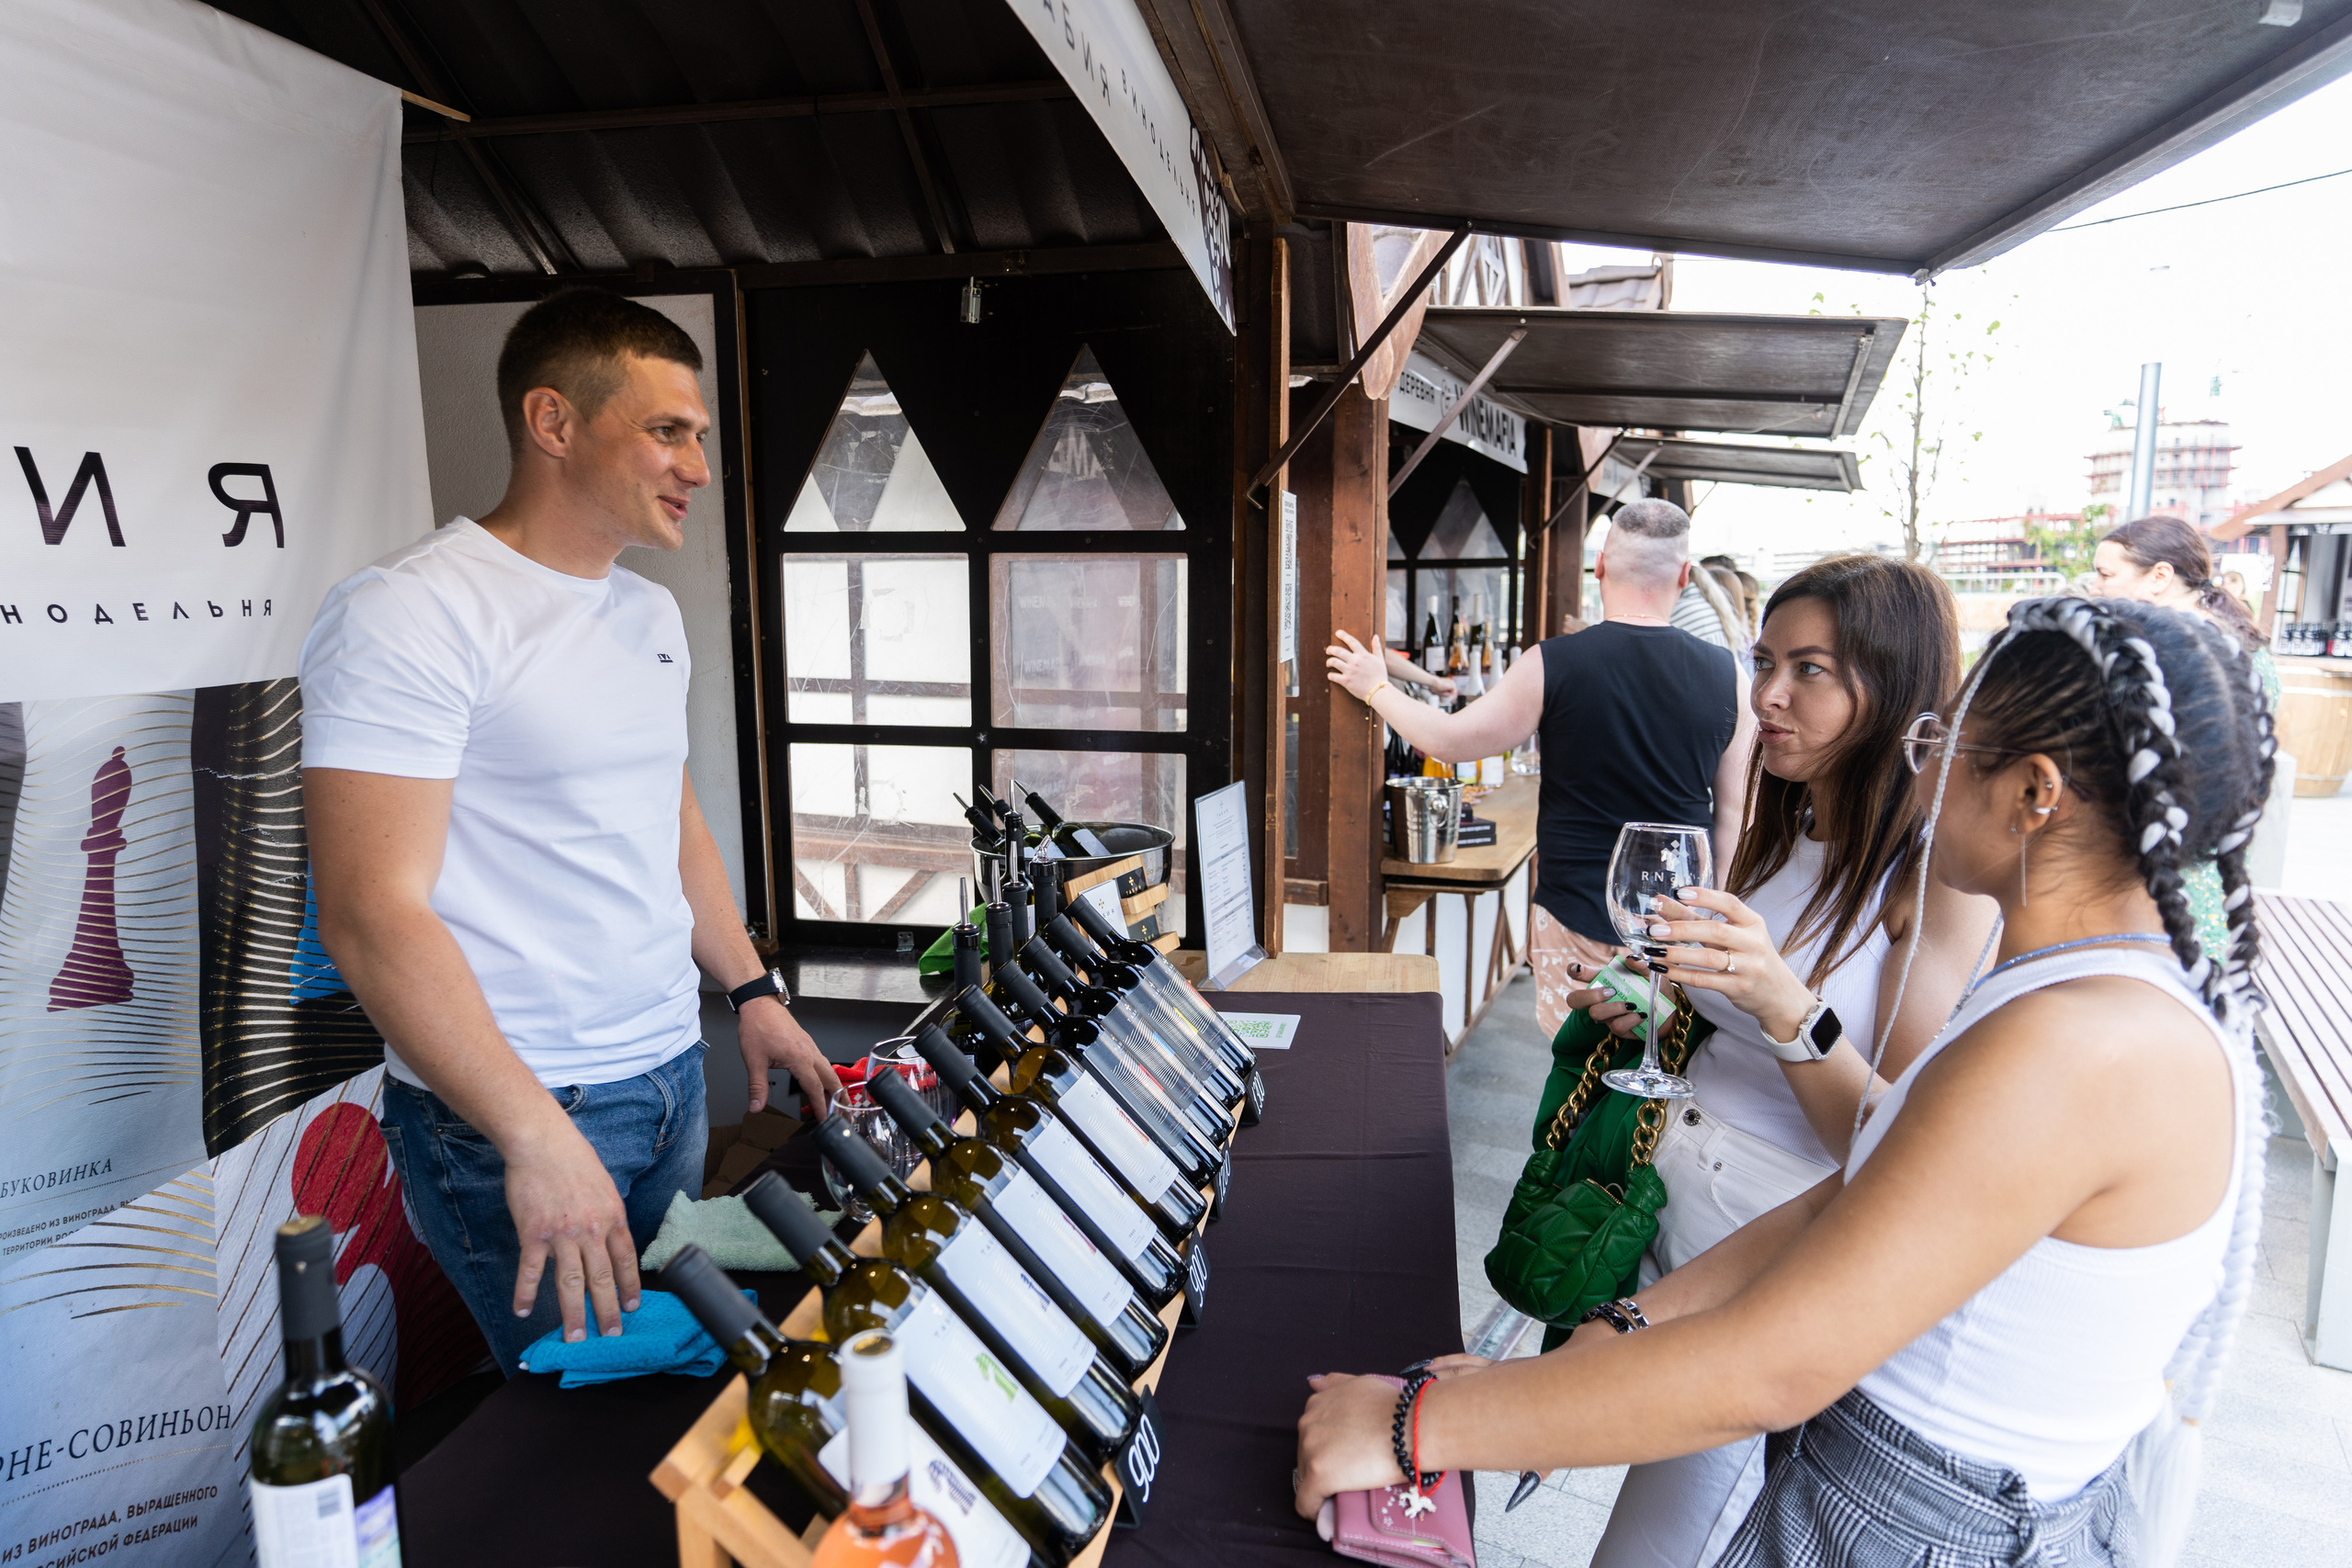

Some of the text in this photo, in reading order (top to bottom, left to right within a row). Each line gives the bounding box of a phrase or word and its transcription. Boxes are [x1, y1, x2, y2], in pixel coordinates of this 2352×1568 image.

[1121, 68, 1195, 218] ВИНОДЕЛЬНЯ
[1454, 383, 1517, 457] WINEMAFIA
[0, 598, 273, 625] НОДЕЛЬНЯ
[0, 1157, 113, 1199] БУКОВИНКА
[3, 1235, 53, 1257] ТЕРРИТОРИИ
[49, 1218, 61, 1228] ИЗ
[1189, 1244, 1208, 1308] 900
[1127, 1413, 1160, 1504] 900
[2, 1485, 218, 1563] ИЗ ВИНОГРАДА, ВЫРАЩЕННОГО
[123, 1515, 198, 1547] ФЕДЕРАЦИИ
